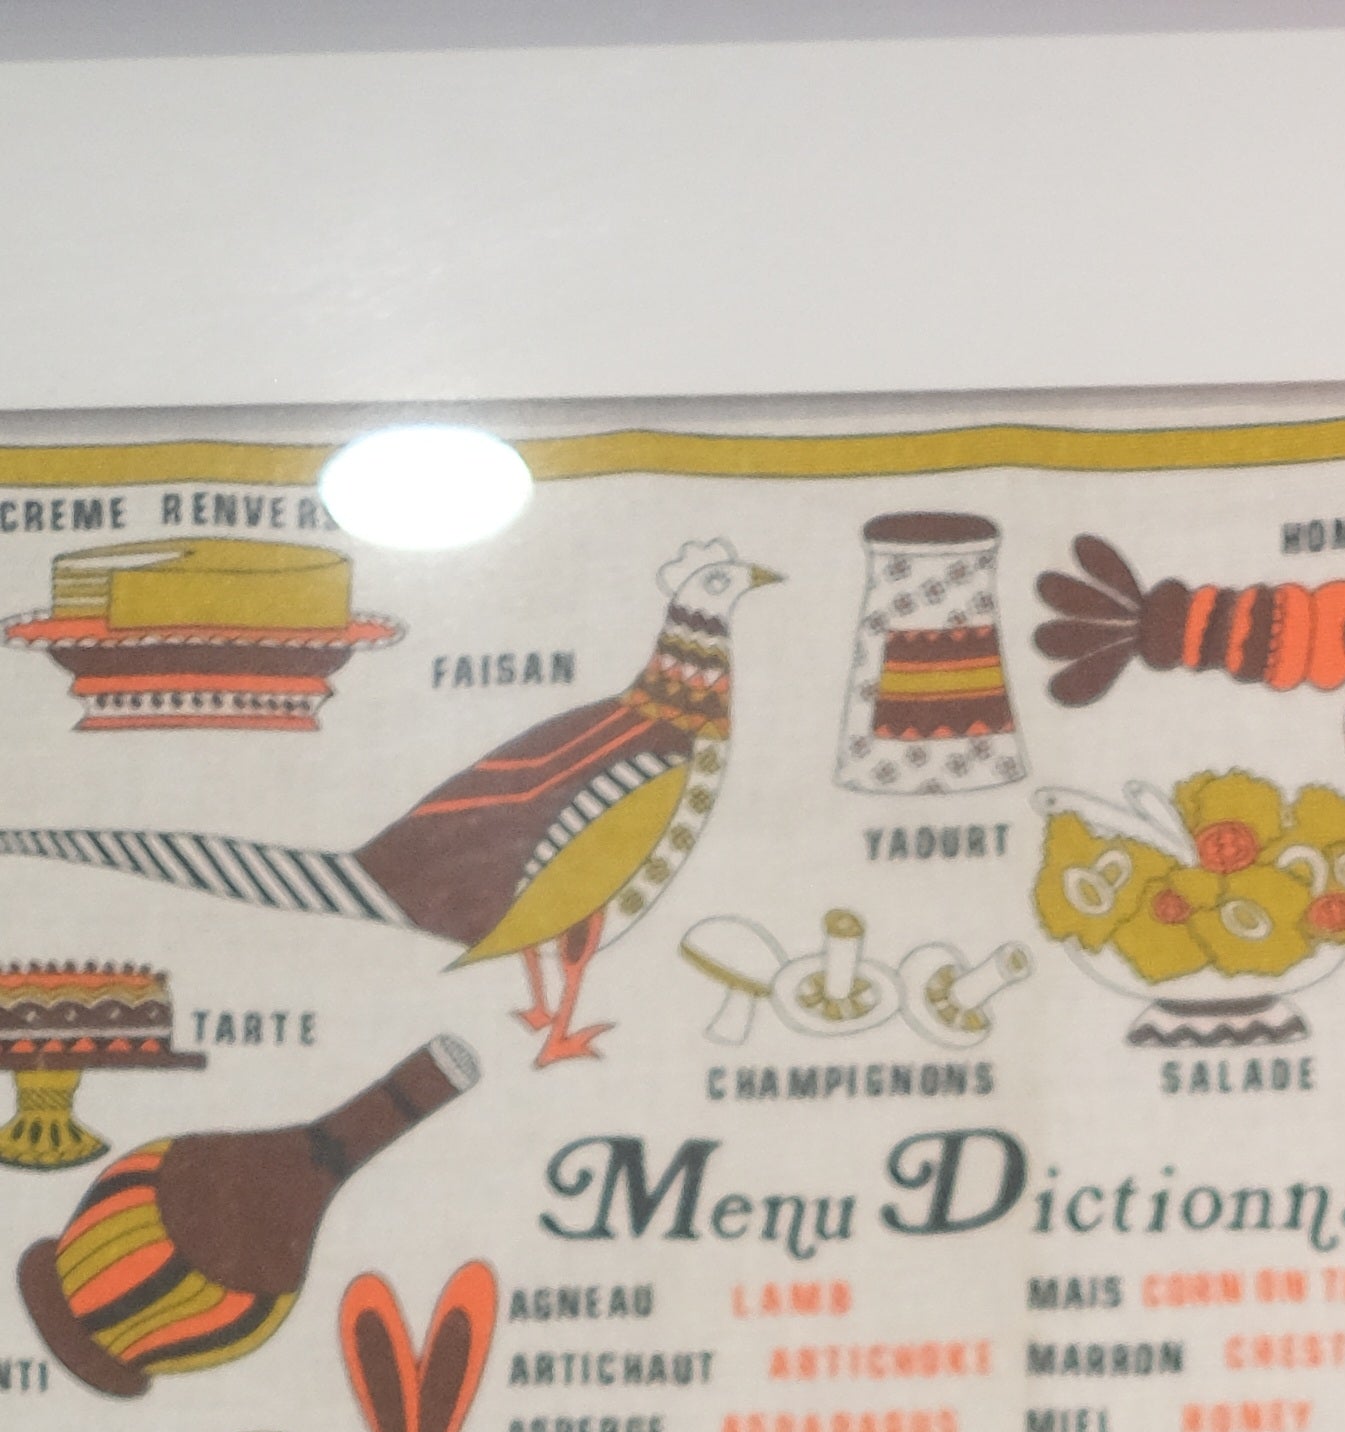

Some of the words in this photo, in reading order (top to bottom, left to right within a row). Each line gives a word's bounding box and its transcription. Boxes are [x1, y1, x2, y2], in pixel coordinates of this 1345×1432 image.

[0, 498, 124, 533] CREME
[432, 651, 575, 688] FAISAN
[864, 823, 1009, 861] YAOURT
[192, 1010, 315, 1046] TARTE
[706, 1062, 995, 1101] CHAMPIGNONS
[1161, 1057, 1313, 1094] SALADE
[539, 1135, 856, 1260] Menu
[509, 1283, 654, 1322] AGNEAU
[1027, 1276, 1123, 1311] MAIS
[509, 1350, 713, 1386] ARTICHAUT
[1026, 1341, 1184, 1376] MARRON
